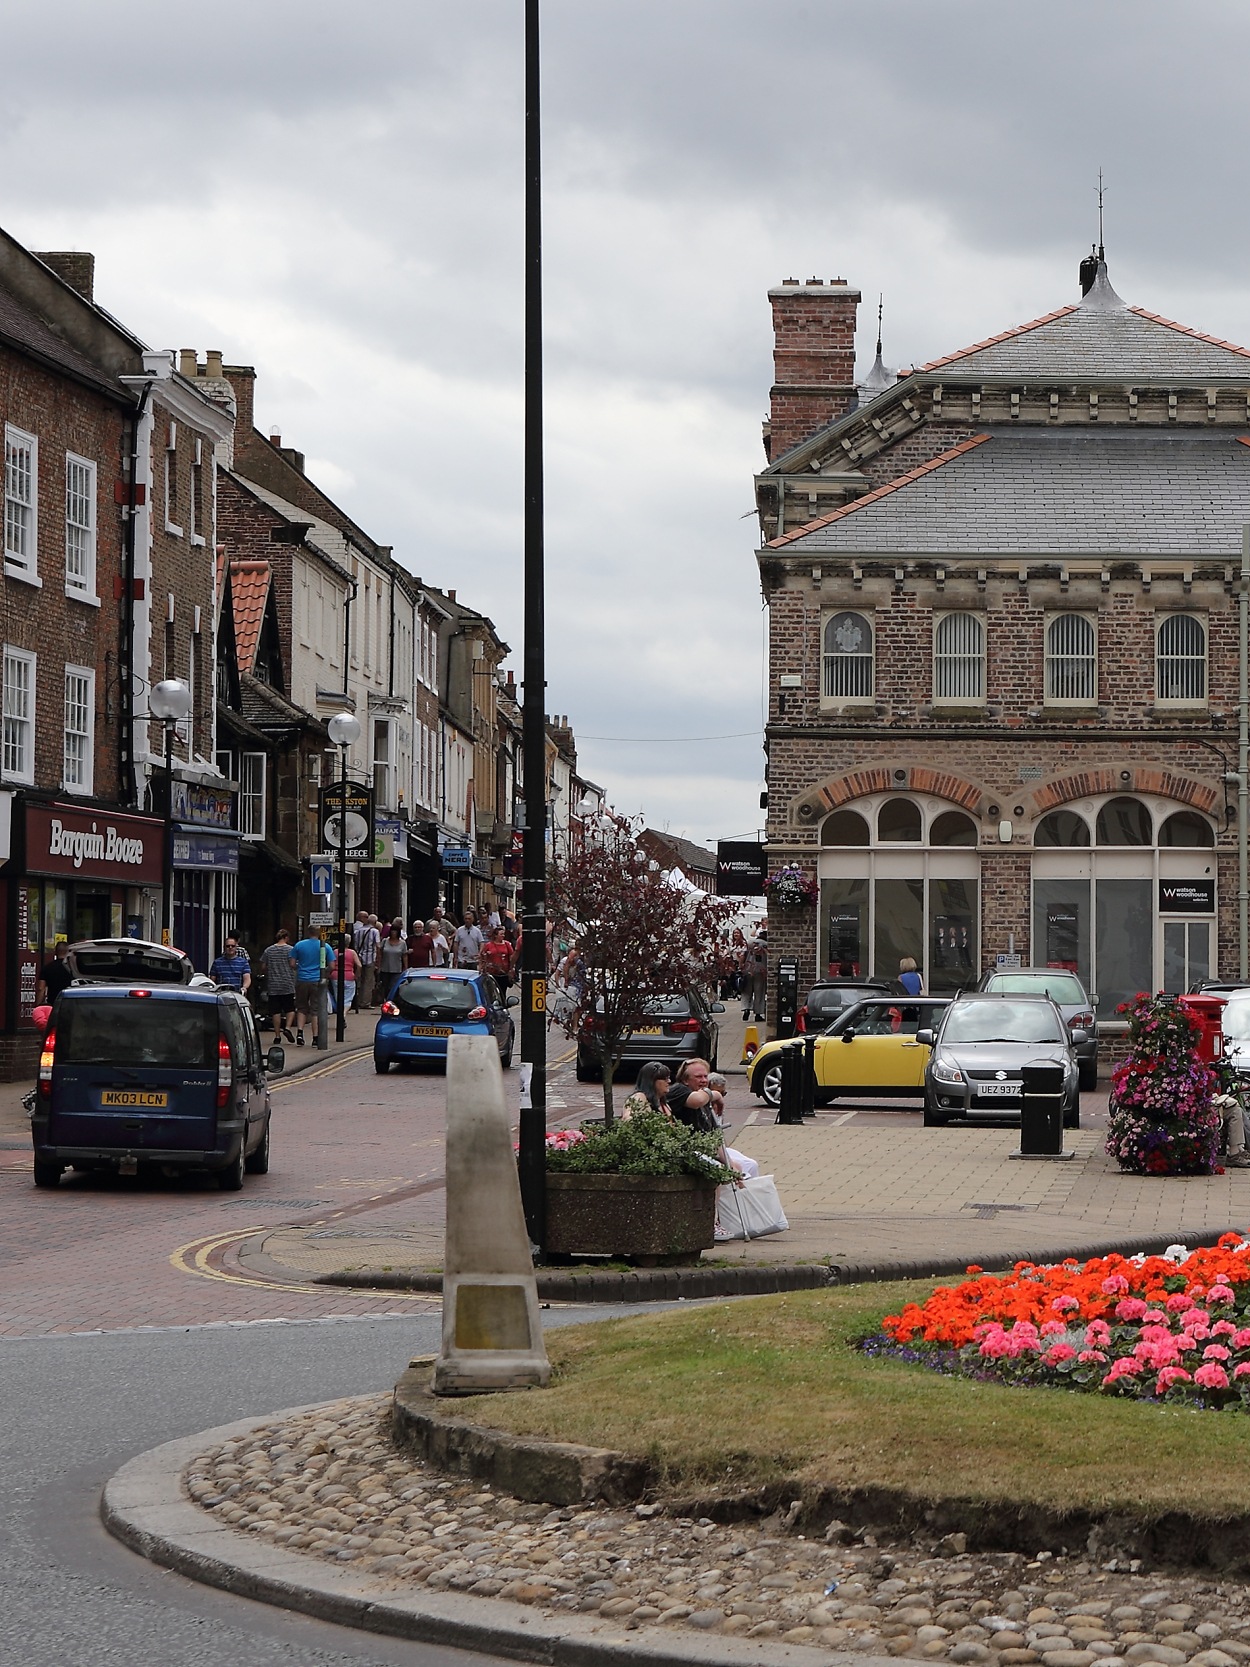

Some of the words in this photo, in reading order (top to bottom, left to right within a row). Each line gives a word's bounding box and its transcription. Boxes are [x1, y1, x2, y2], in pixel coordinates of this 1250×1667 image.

[375, 828, 399, 836] ALIFAX
[50, 819, 105, 868] Bargain
[105, 827, 144, 865] Booze
[374, 856, 390, 864] fam
[981, 1085, 998, 1094] UEZ
[1000, 1086, 1021, 1094] 9372
[105, 1093, 136, 1104] MK03
[139, 1095, 164, 1105] LCN
